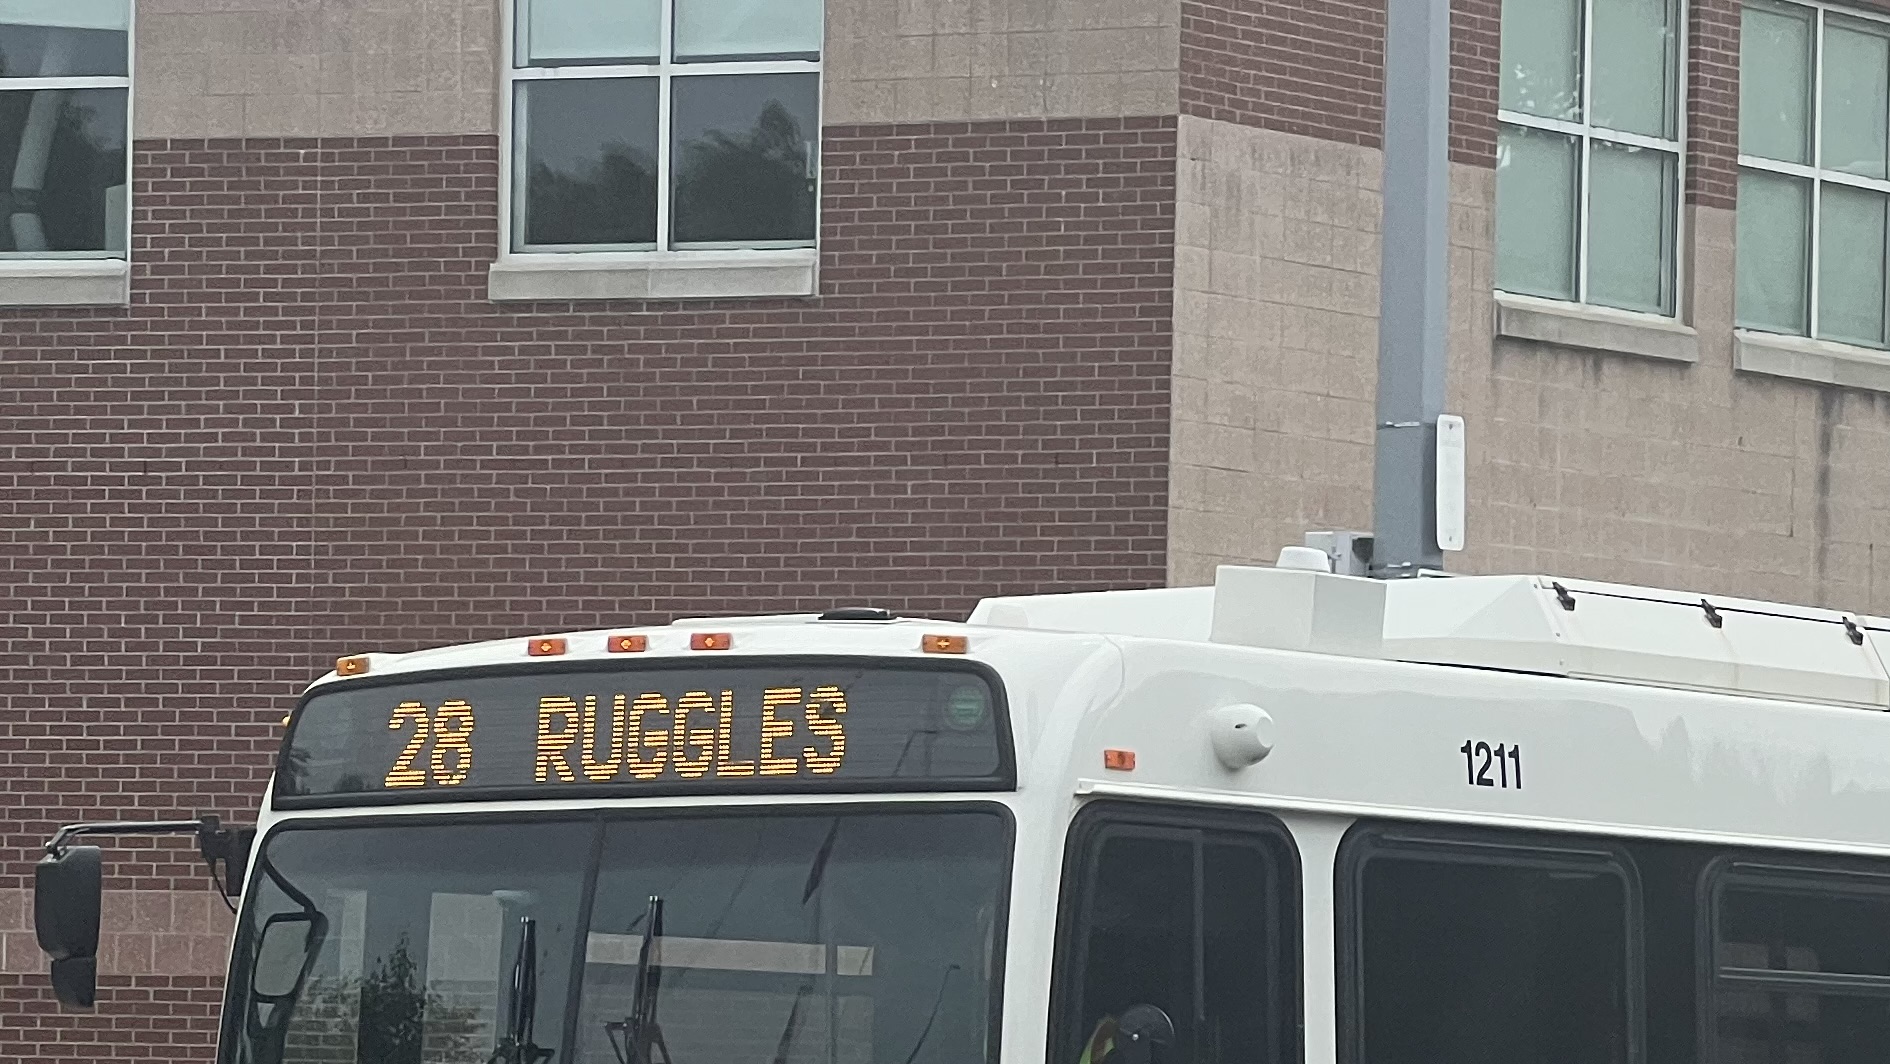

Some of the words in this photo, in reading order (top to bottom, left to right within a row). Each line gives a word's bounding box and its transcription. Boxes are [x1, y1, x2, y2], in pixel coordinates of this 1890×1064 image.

[384, 699, 475, 787] 28
[534, 685, 848, 783] RUGGLES
[1460, 739, 1522, 790] 1211
